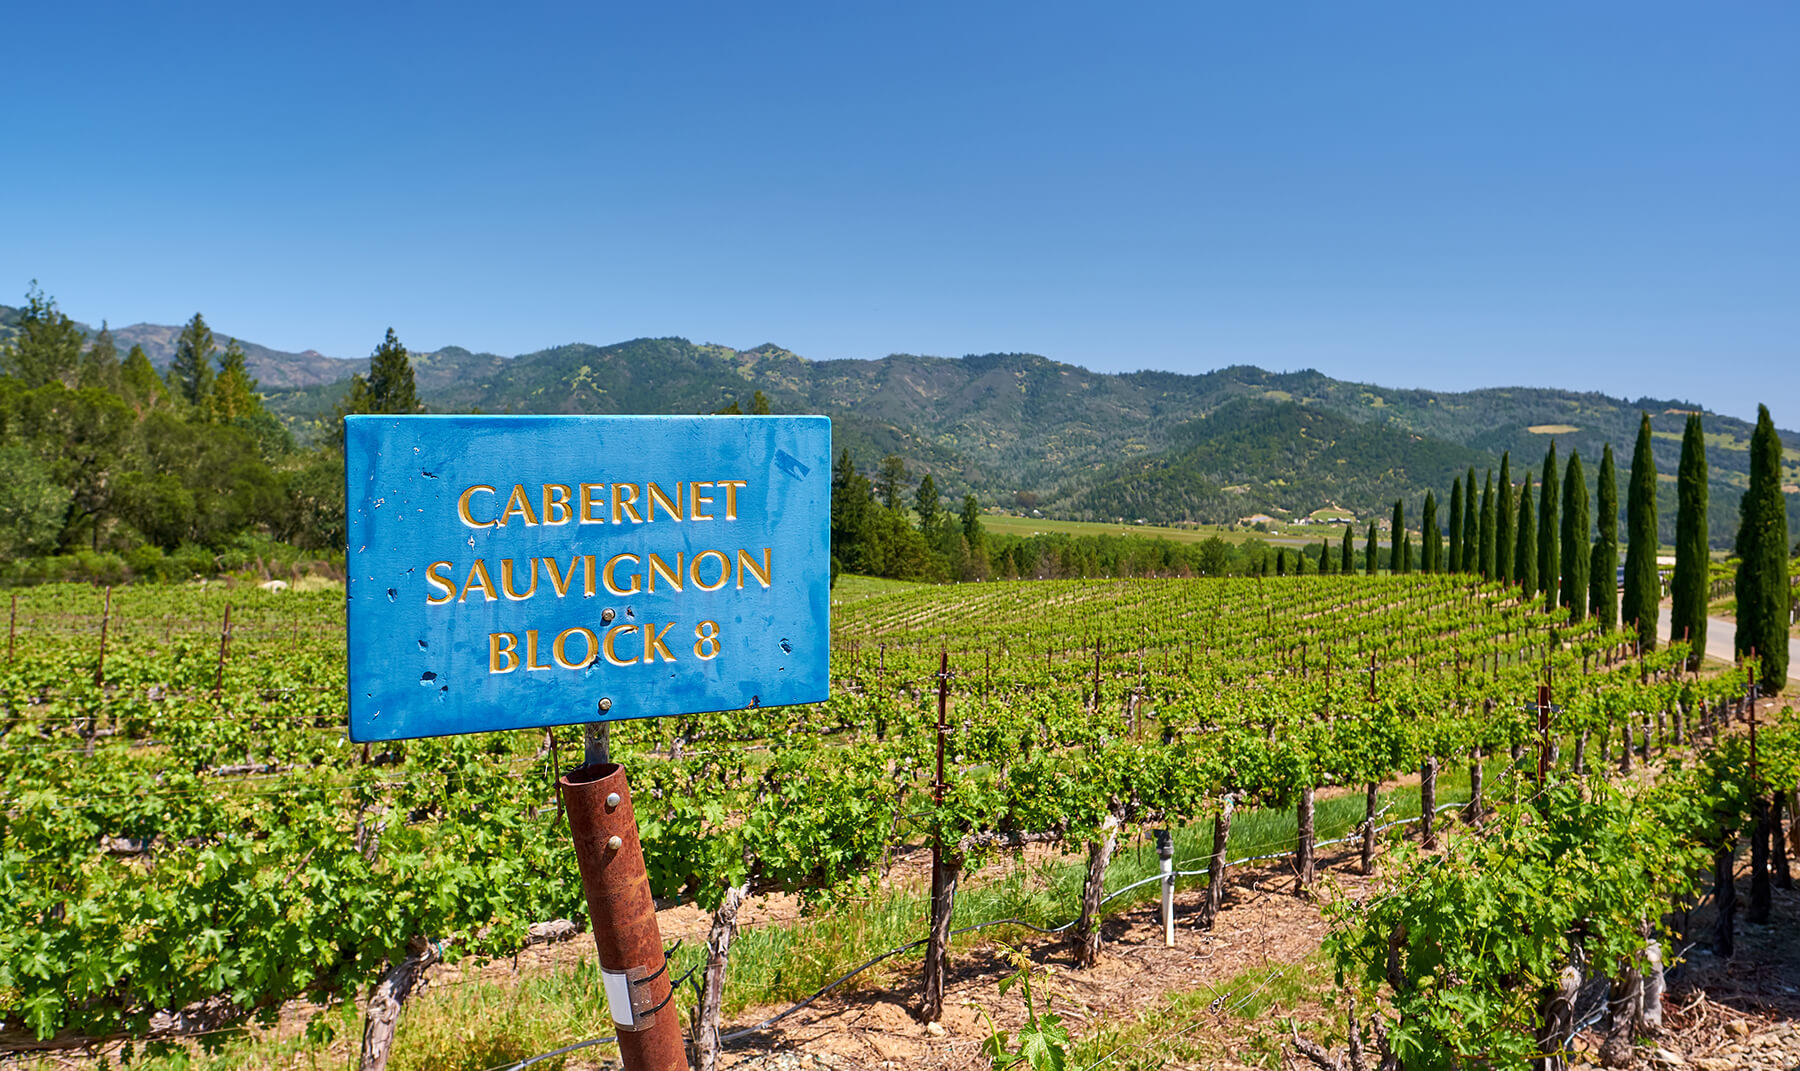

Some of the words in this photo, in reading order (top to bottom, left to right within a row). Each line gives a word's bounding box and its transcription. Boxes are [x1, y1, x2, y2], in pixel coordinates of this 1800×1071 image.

[457, 480, 748, 529] CABERNET
[425, 547, 772, 605] SAUVIGNON
[489, 621, 677, 674] BLOCK
[693, 619, 721, 661] 8
